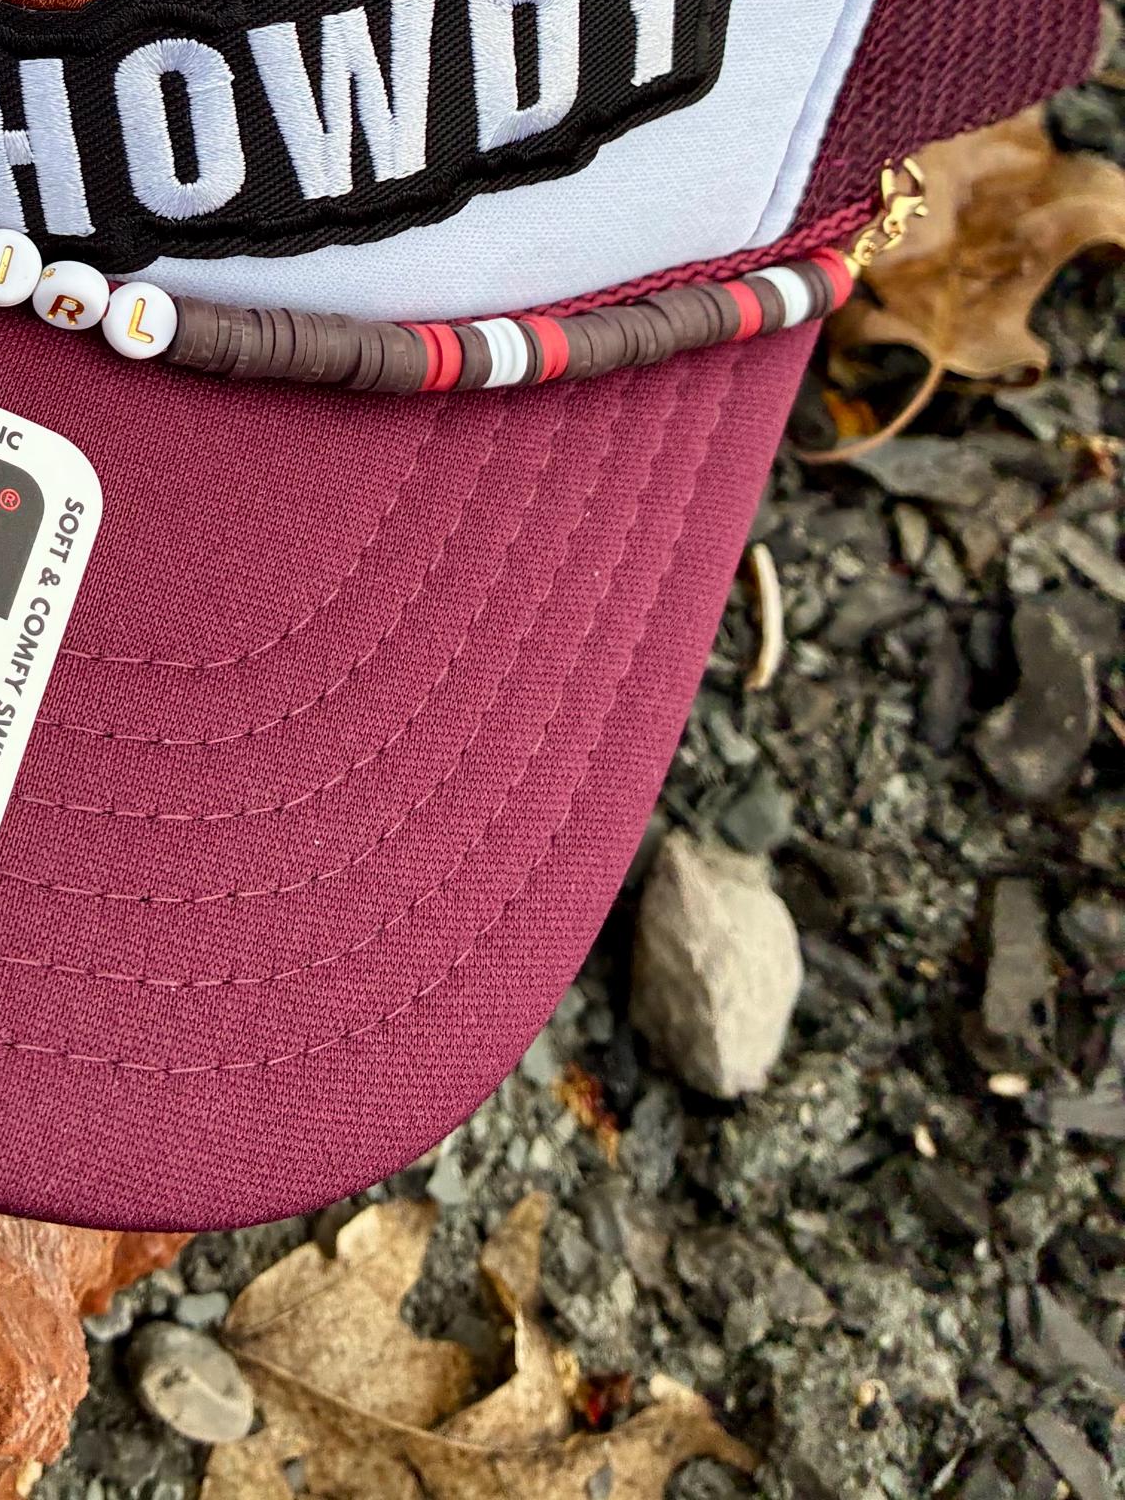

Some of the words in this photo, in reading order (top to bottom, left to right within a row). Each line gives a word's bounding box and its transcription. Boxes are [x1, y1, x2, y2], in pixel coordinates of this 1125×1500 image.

[47, 497, 84, 564] SOFT
[38, 568, 60, 588] &
[5, 597, 50, 697] COMFY
